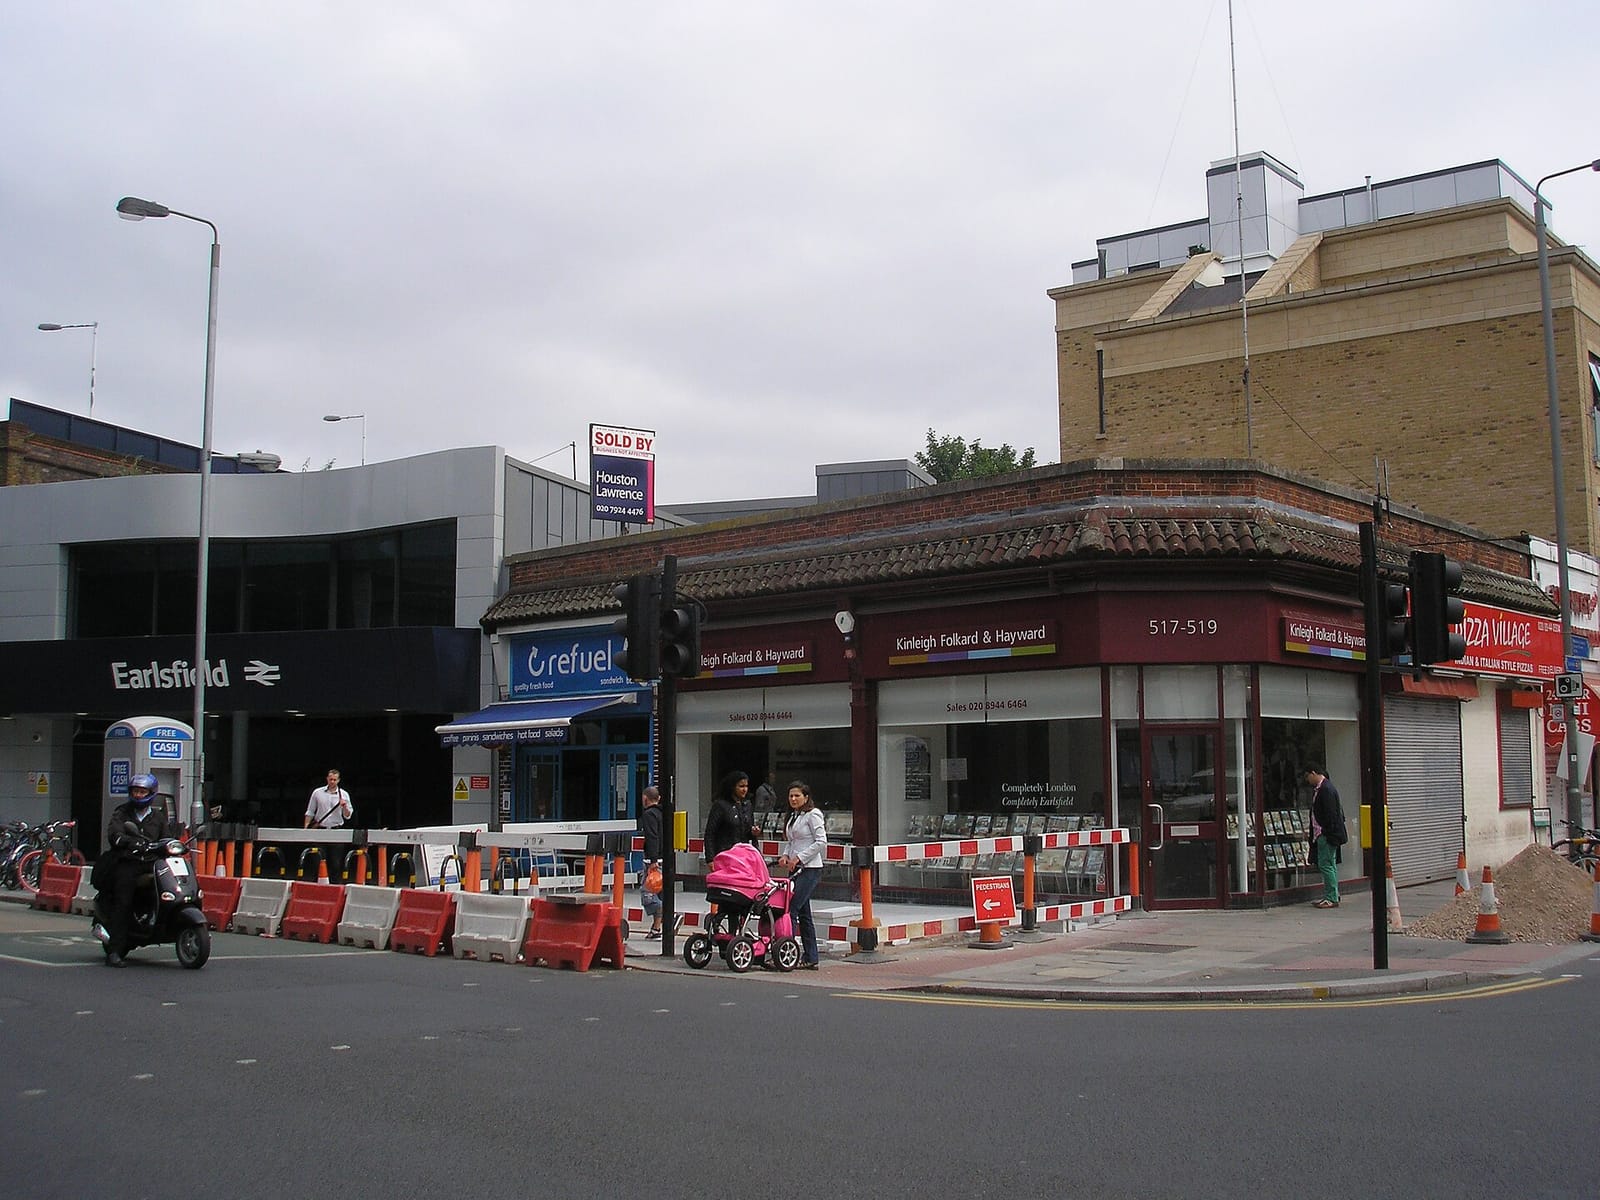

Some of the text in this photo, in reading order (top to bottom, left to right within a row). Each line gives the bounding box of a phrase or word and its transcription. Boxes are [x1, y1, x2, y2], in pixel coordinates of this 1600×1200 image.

[595, 432, 653, 451] SOLD BY
[596, 470, 638, 486] Houston
[596, 484, 644, 500] Lawrence
[610, 506, 626, 515] 7924
[627, 507, 644, 516] 4476
[1149, 619, 1218, 635] 517-519
[896, 625, 1046, 652] Kinleigh Folkard & Hayward
[1289, 623, 1366, 648] Kinleigh Folkard & Haywar
[548, 639, 612, 676] refuel
[722, 650, 753, 665] Folkard
[755, 650, 763, 662] &
[765, 646, 805, 664] Hayward
[1475, 657, 1480, 667] &
[1480, 657, 1501, 670] ITALIAN
[1500, 660, 1517, 672] STYLE
[1517, 662, 1533, 673] PIZZAS
[514, 681, 554, 693] quality fresh food
[600, 676, 624, 686] sandwich
[946, 699, 1027, 712] Sales 020 8944 6464
[746, 713, 759, 721] 020
[760, 712, 776, 720] 8944
[776, 711, 793, 720] 6464
[156, 729, 177, 737] FREE
[482, 731, 514, 741] sandwiches
[517, 730, 528, 739] hot
[528, 729, 541, 738] food
[544, 727, 564, 738] salads
[153, 742, 179, 752] CASH
[113, 764, 127, 774] FREE
[112, 775, 128, 785] CASH
[1001, 782, 1077, 795] Completely London
[1001, 796, 1074, 809] Completely Earlsfield
[975, 881, 1010, 891] PEDESTRIANS
